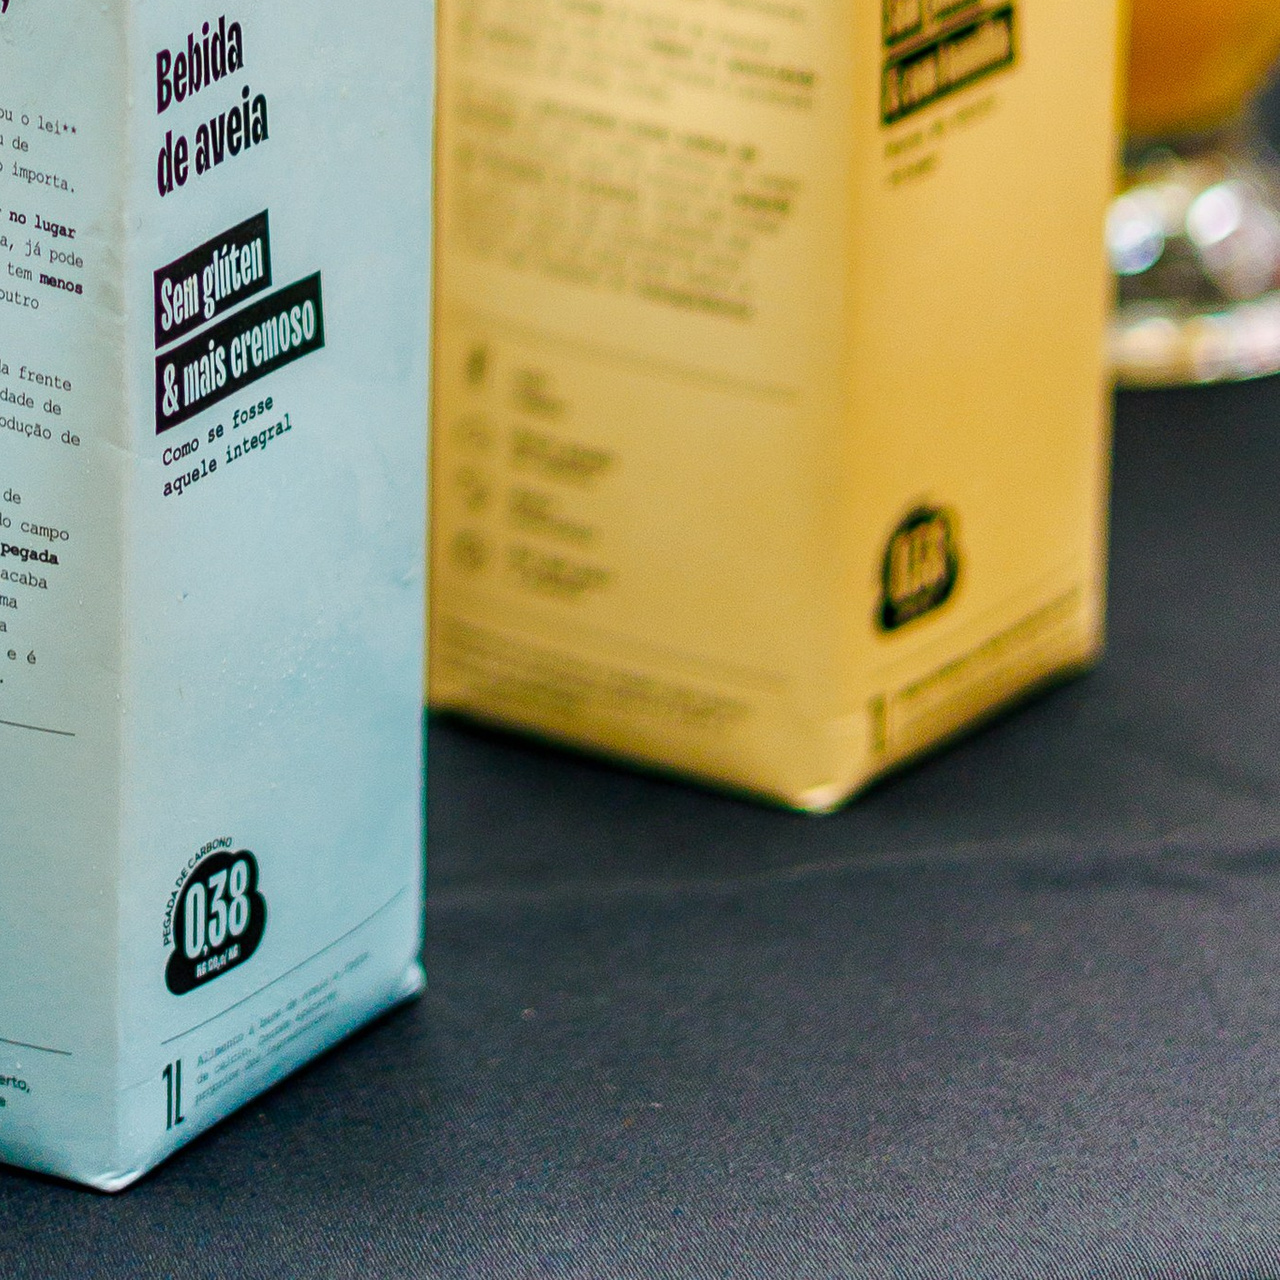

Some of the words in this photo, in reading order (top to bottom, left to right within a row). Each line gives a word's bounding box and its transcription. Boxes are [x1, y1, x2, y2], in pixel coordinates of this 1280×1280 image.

[156, 14, 244, 116] Bebida
[11, 136, 29, 153] de
[21, 113, 30, 126] o
[157, 130, 189, 197] de
[195, 85, 270, 175] aveia
[11, 161, 76, 194] importa.
[9, 210, 27, 226] no
[34, 214, 77, 240] lugar
[161, 277, 199, 331] Sem
[202, 237, 264, 319] glúten
[19, 366, 72, 391] frente
[162, 363, 179, 417] &
[183, 339, 227, 406] mais
[230, 299, 316, 379] cremoso
[162, 437, 199, 467] Como
[207, 422, 224, 444] se
[232, 394, 274, 430] fosse
[162, 456, 217, 497] aquele
[225, 413, 293, 464] integral
[162, 889, 179, 947] PEGADA
[176, 865, 188, 888] DE
[187, 835, 233, 869] CARBONO
[184, 858, 250, 960] 0,38
